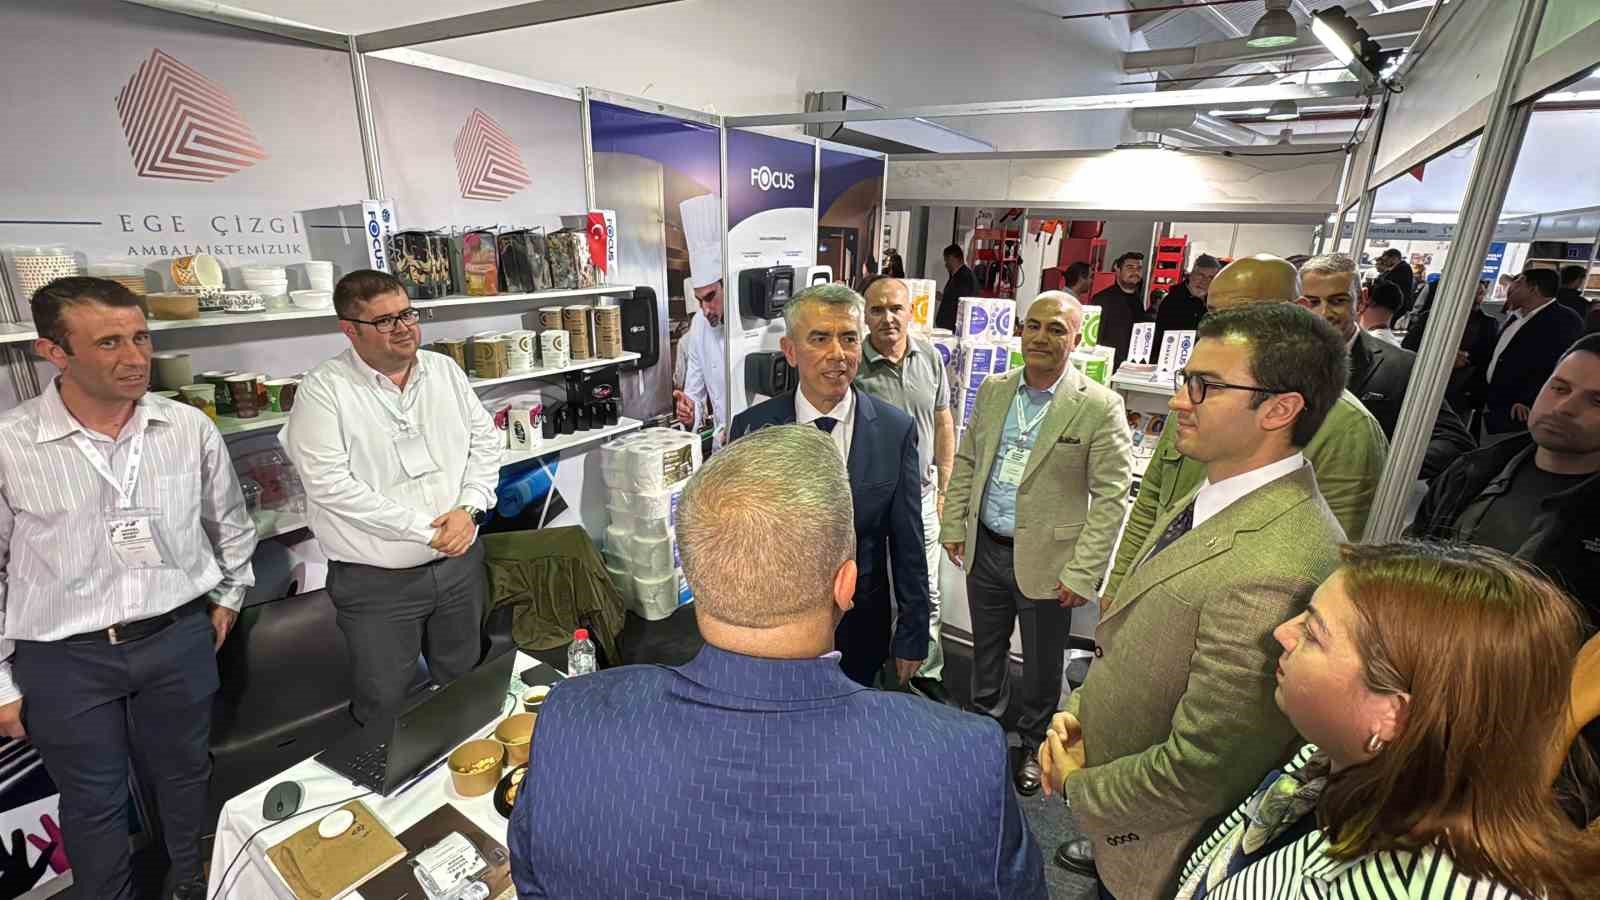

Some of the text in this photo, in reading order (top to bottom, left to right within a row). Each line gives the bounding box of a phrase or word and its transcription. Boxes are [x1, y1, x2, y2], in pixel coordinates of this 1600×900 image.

[751, 166, 795, 191] FOCUS
[118, 214, 185, 233] EGE
[368, 210, 384, 269] FOCUS
[606, 218, 615, 262] FOCUS
[1142, 328, 1152, 356] FOCUS
[1179, 335, 1192, 366] FOCUS
